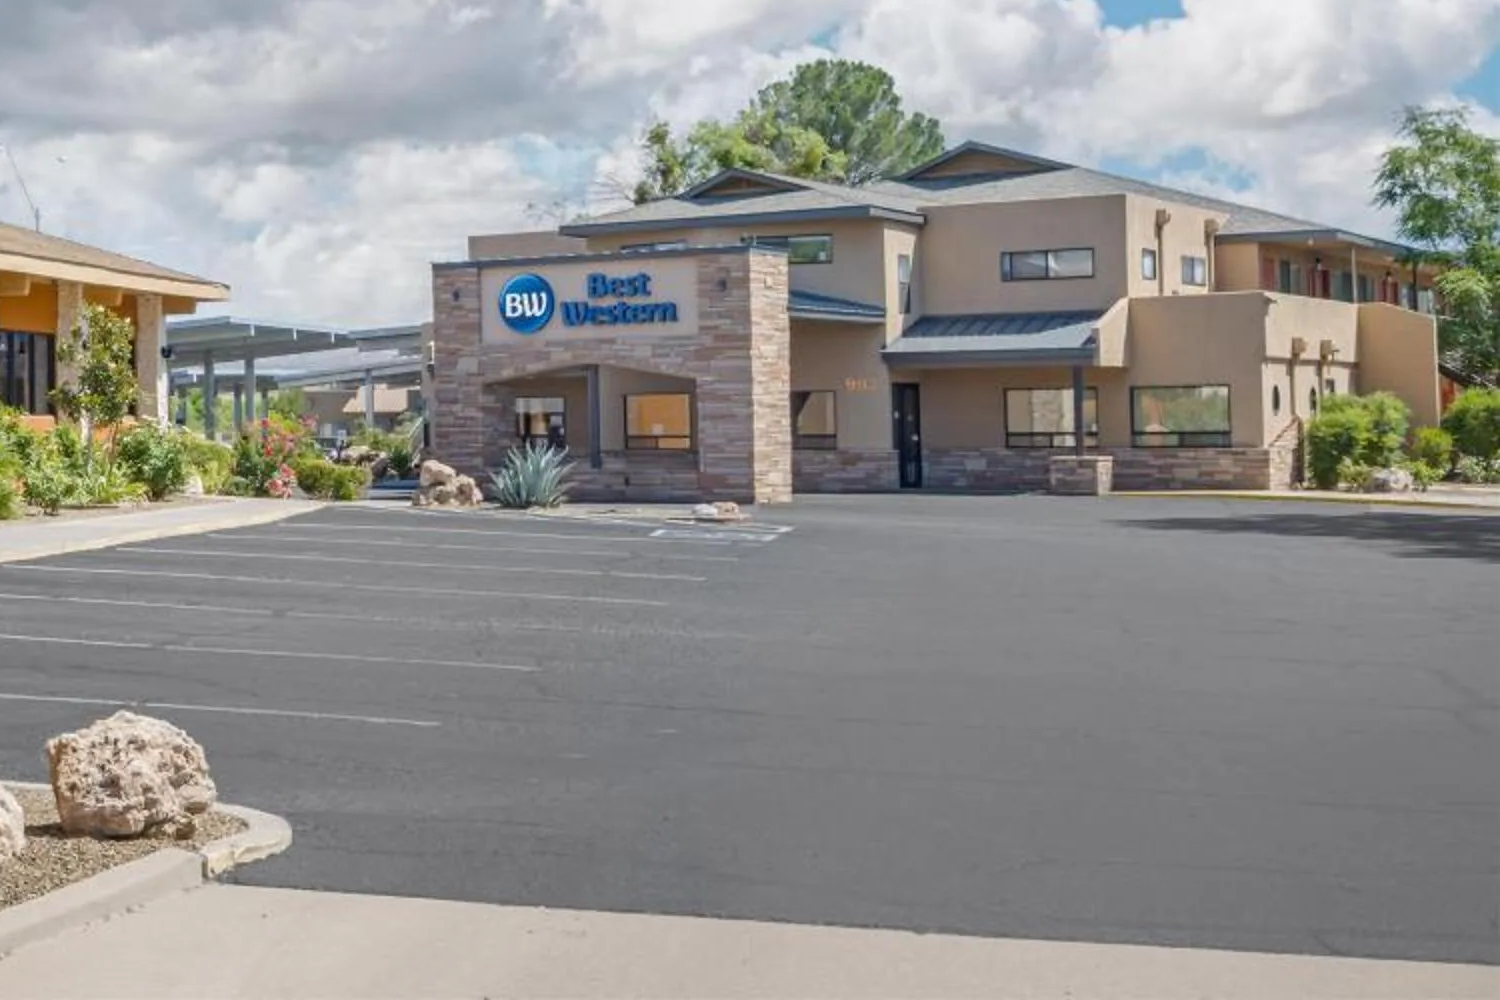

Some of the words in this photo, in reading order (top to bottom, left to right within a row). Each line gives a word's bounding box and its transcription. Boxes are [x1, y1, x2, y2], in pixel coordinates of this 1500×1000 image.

[586, 272, 653, 299] Best
[504, 291, 548, 319] BW
[560, 301, 679, 327] Western
